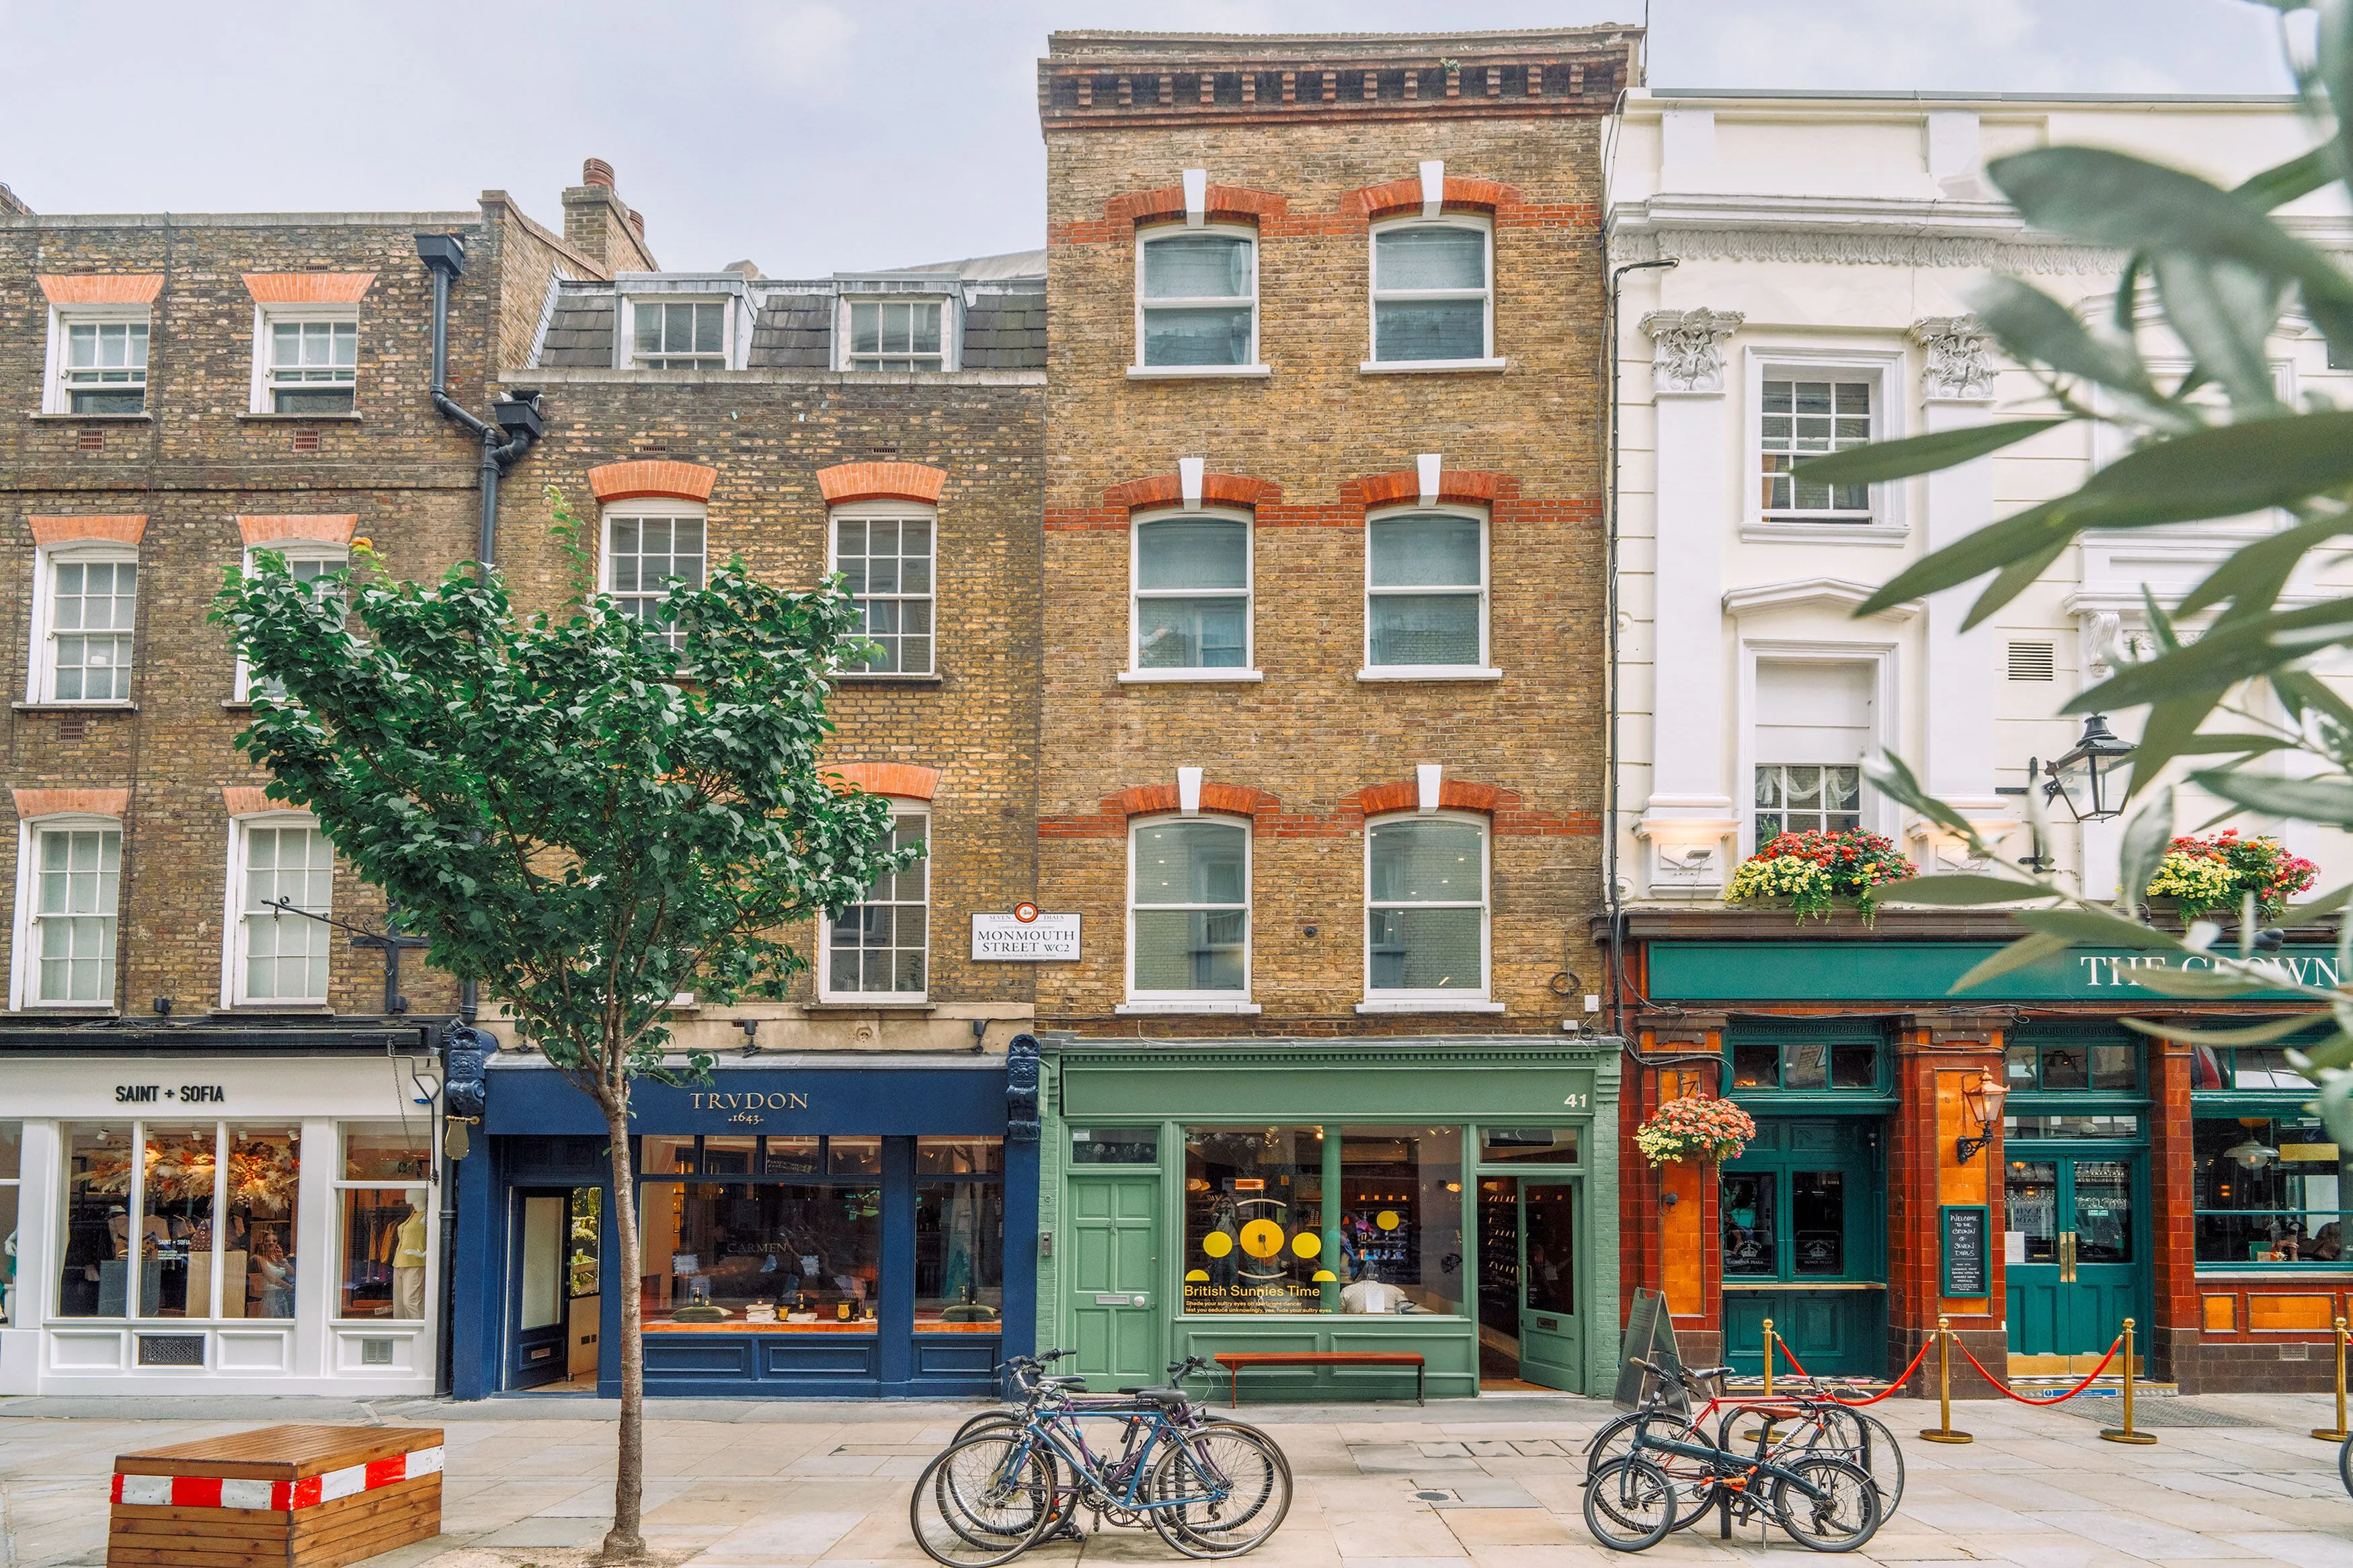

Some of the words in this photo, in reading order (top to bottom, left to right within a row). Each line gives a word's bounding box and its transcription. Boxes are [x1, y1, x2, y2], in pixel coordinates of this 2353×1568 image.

[978, 931, 1074, 940] MONMOUTH
[982, 942, 1039, 952] STREET
[1044, 944, 1070, 952] WC2
[2182, 957, 2341, 986] CWN
[116, 1085, 159, 1102] SAINT
[164, 1089, 175, 1098] +
[180, 1085, 224, 1102] SOFIA
[689, 1093, 808, 1110] TRVDON
[1564, 1094, 1587, 1108] 41
[1950, 1214, 1979, 1222] WELCOME
[727, 1243, 789, 1253] CARMEN
[1185, 1285, 1227, 1296] British
[1230, 1285, 1284, 1296] Sunnies
[1287, 1285, 1320, 1296] Time
